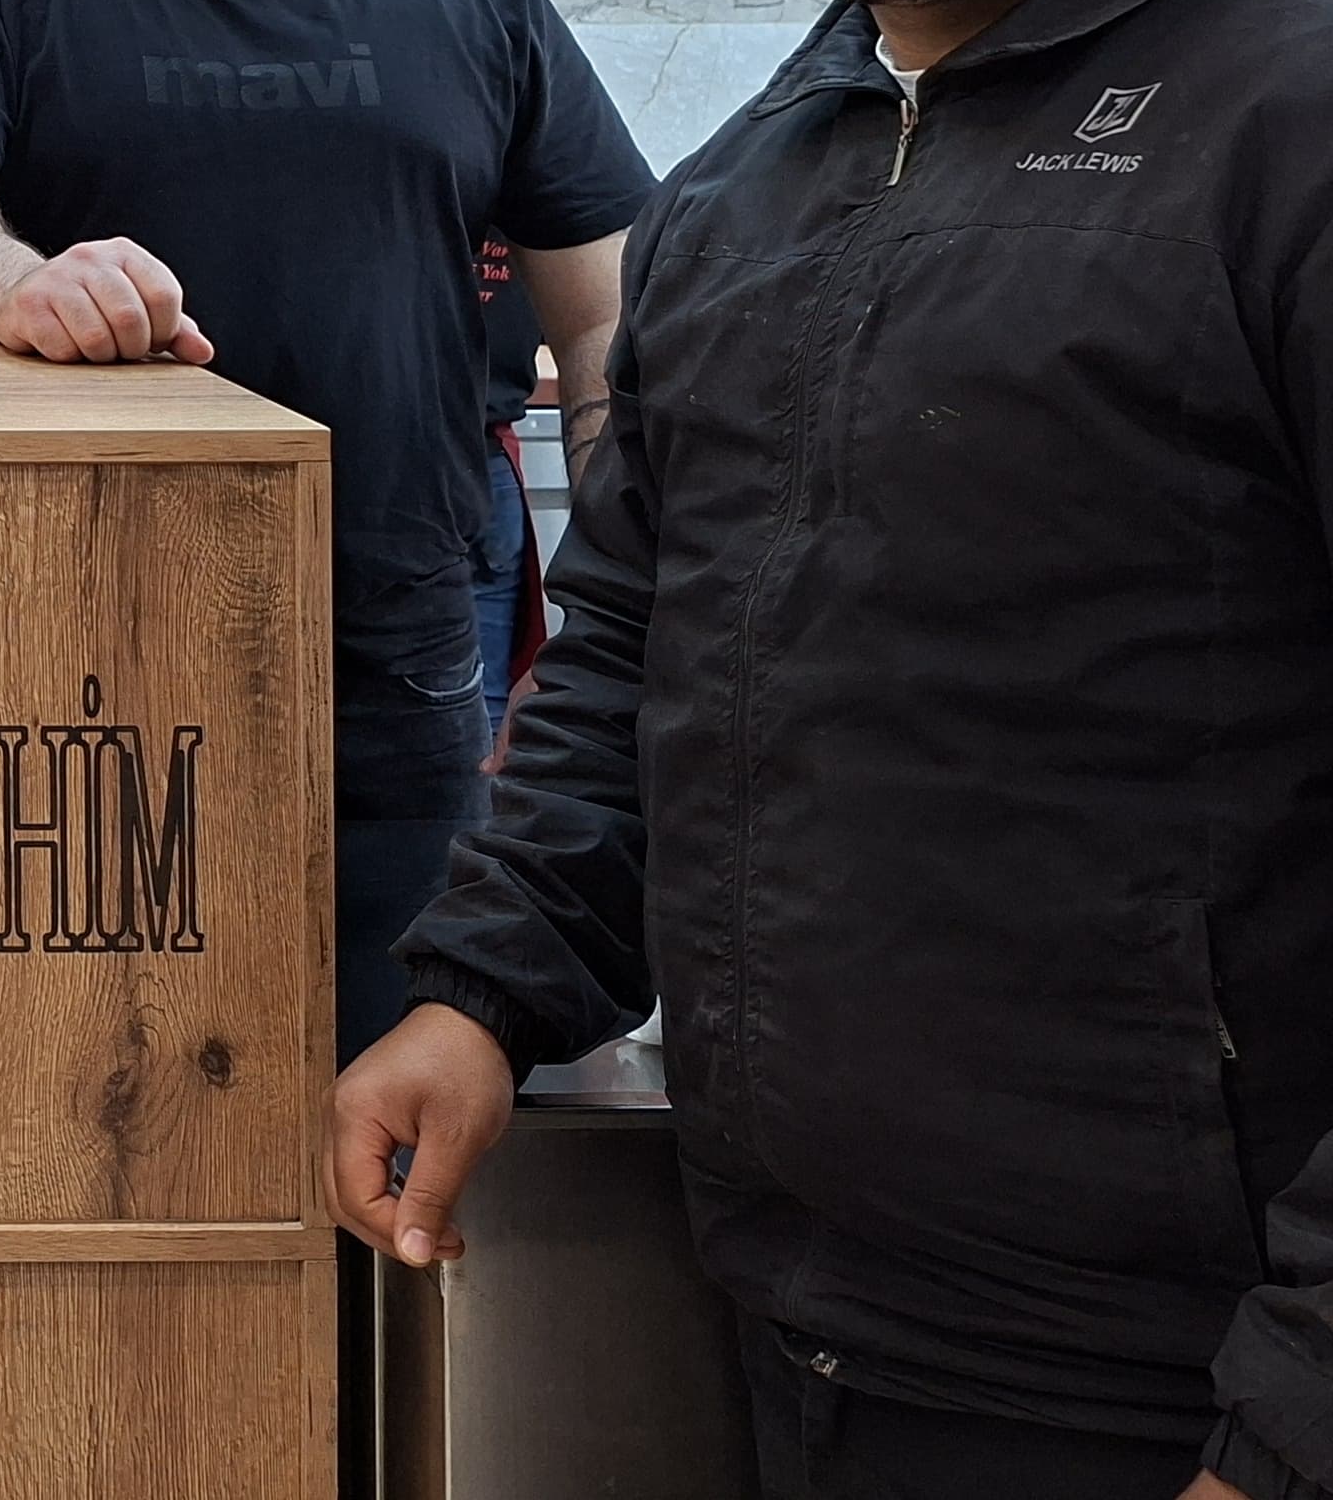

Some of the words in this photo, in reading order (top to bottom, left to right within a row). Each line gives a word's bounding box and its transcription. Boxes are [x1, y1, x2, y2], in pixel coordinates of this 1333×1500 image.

[142, 43, 381, 110] mavi
[1015, 152, 1075, 172] JACK
[1073, 152, 1143, 173] LEWIS
[482, 263, 510, 281] Yok
